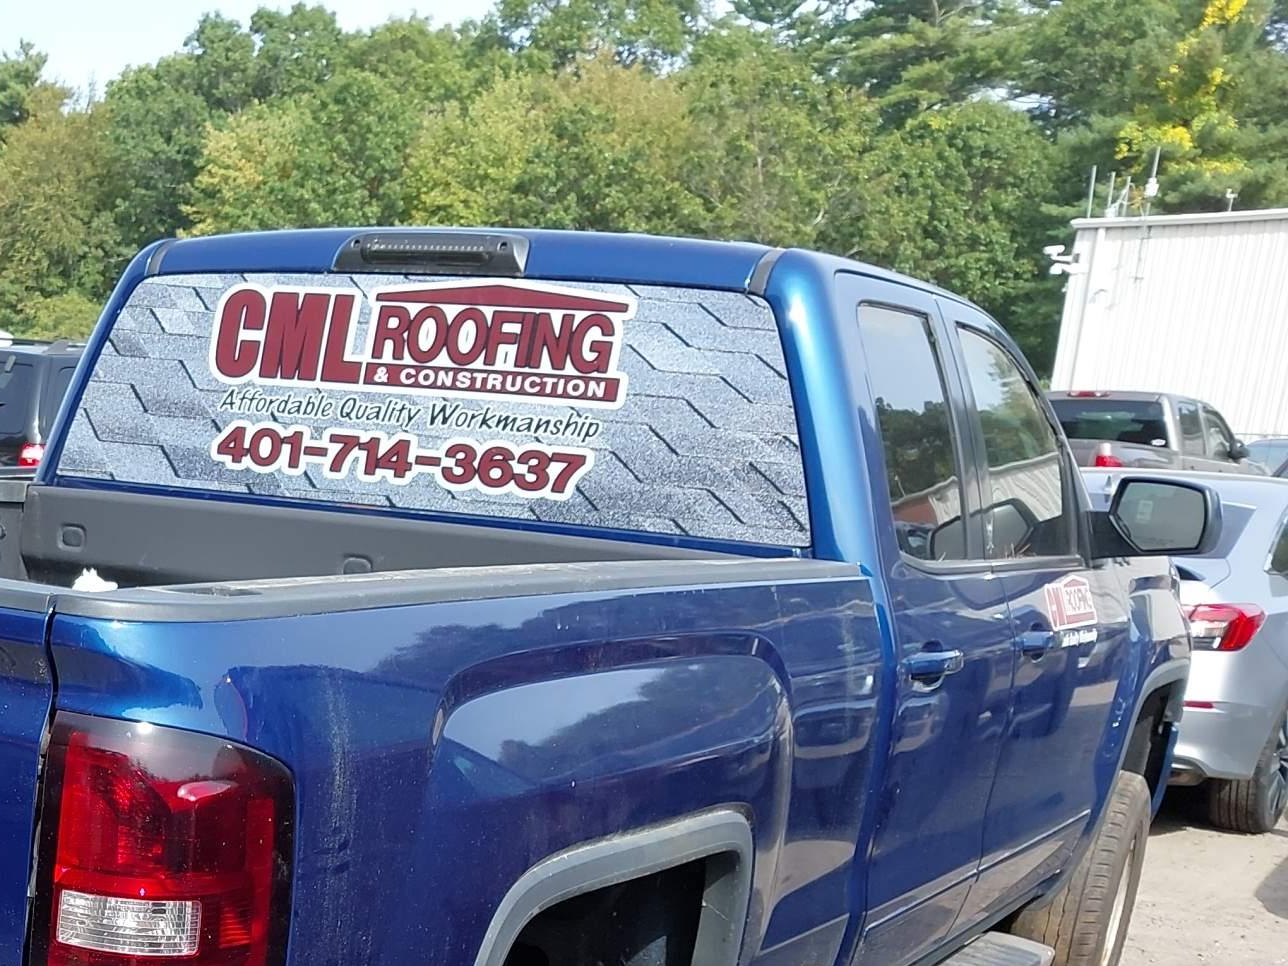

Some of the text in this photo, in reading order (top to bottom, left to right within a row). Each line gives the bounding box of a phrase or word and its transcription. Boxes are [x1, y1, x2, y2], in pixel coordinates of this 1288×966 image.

[215, 288, 615, 384] CML ROOFING
[372, 366, 607, 398] & CONSTRUCTION
[219, 388, 600, 443] Affordable Quality Workmanship
[216, 425, 587, 494] 401-714-3637
